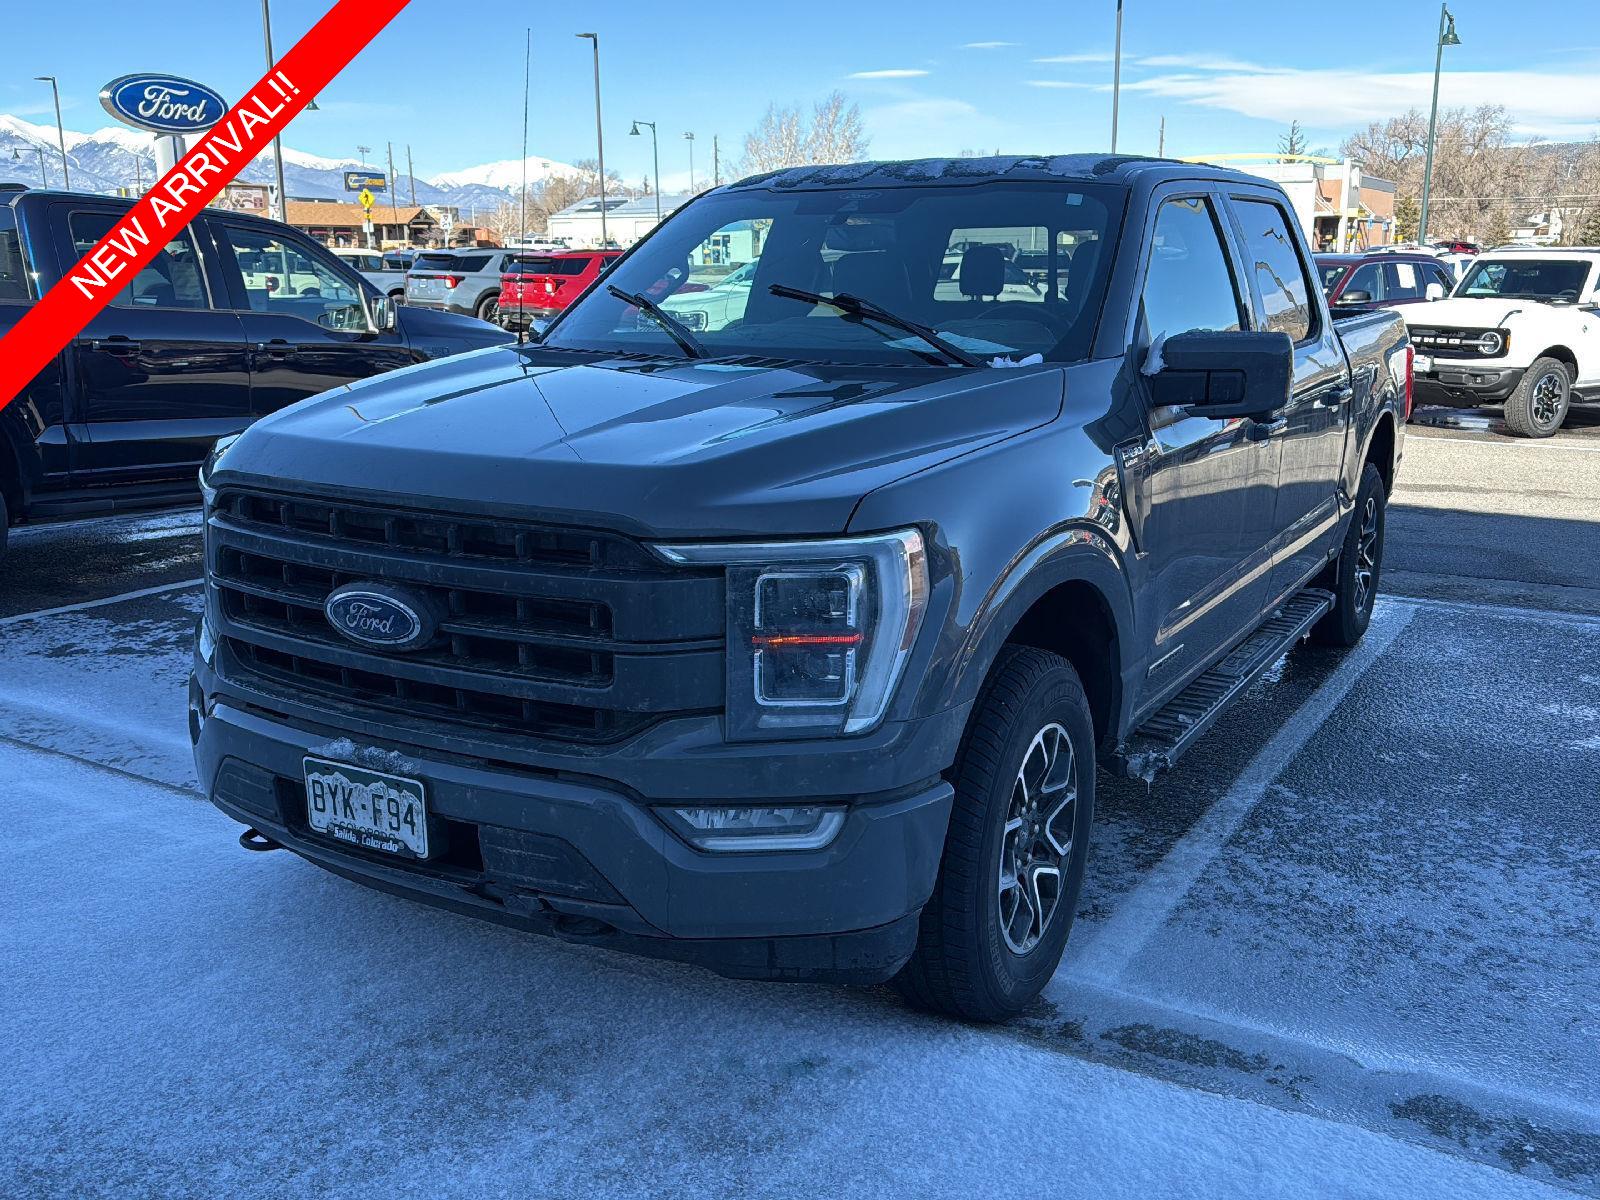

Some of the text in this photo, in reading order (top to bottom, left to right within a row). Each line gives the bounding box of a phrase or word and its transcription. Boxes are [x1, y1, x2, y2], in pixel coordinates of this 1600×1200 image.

[138, 85, 207, 122] Ford
[346, 602, 394, 633] Ford
[361, 834, 398, 852] Colorado
